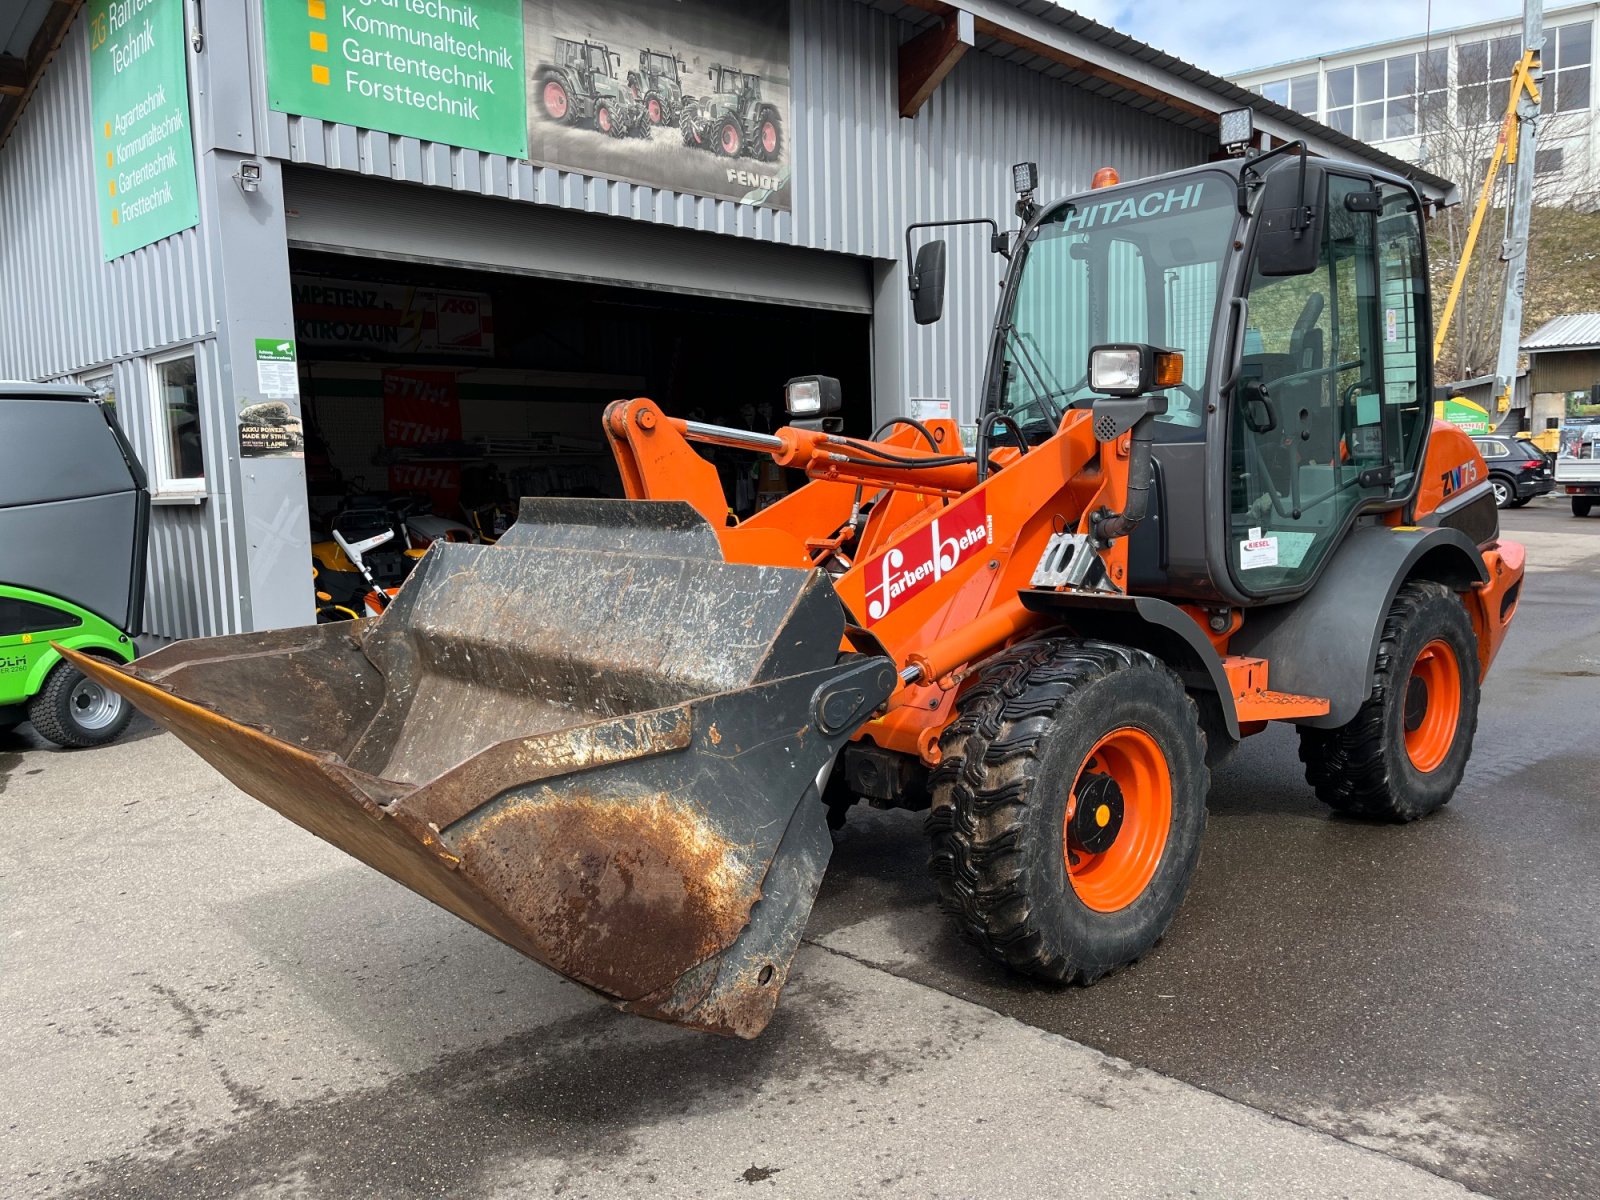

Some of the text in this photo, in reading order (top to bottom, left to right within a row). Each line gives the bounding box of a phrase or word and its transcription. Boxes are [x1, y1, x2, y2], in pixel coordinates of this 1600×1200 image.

[110, 18, 155, 76] Technik
[341, 5, 515, 70] Kommunaltechnik
[342, 38, 495, 95] Gartentechnik
[114, 83, 166, 136] Agrartechnik
[346, 70, 480, 121] Forsttechnik
[117, 107, 184, 165] Kommunaltechnik
[119, 145, 178, 194] Gartentechnik
[726, 168, 781, 191] FENDT
[121, 181, 173, 223] Forsttechnik
[1062, 183, 1204, 232] HITACHI
[441, 298, 476, 314] AKO
[384, 375, 451, 408] STIHL
[393, 463, 461, 489] STIHL
[1441, 459, 1477, 497] ZW75
[1248, 540, 1270, 549] KIESEL
